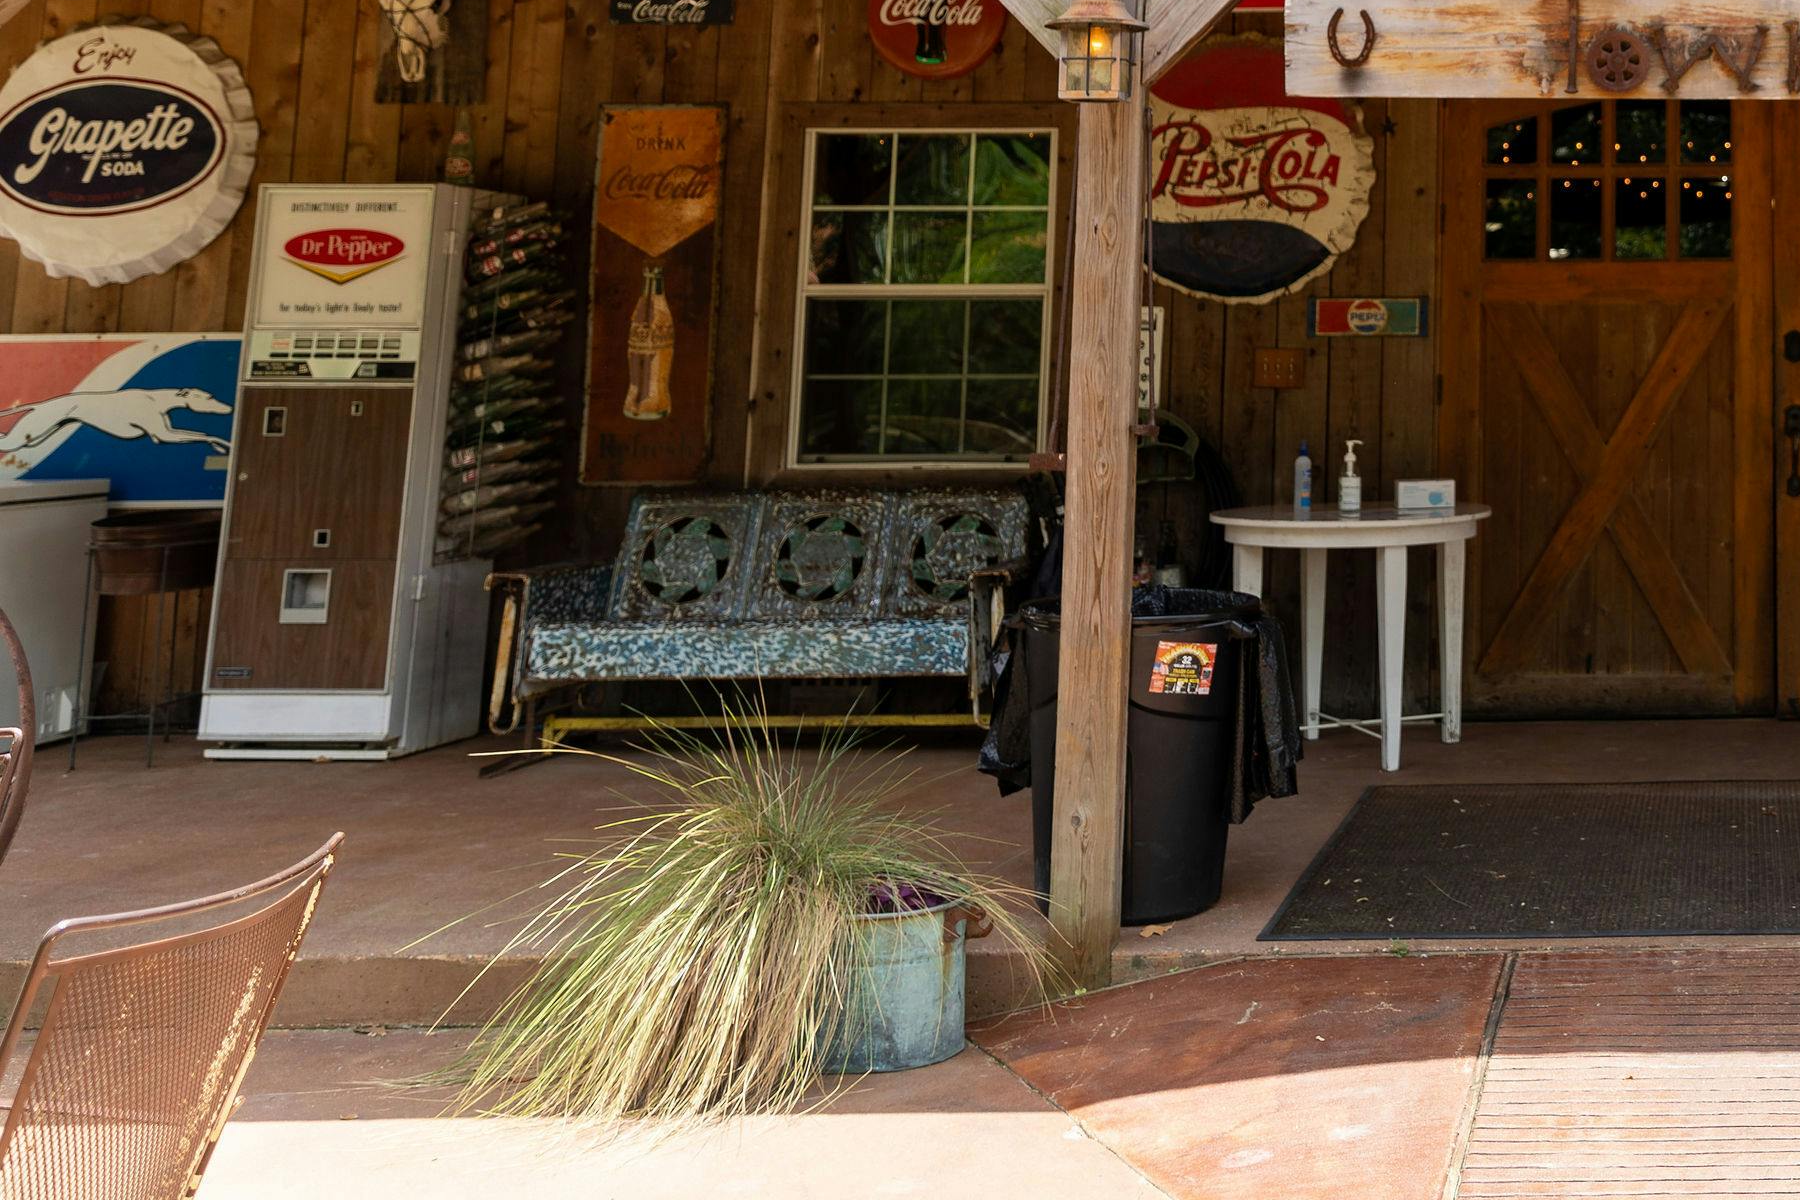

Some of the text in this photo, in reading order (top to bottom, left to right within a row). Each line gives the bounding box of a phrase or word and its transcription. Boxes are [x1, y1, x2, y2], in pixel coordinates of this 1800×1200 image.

[73, 36, 137, 74] Enjoy
[14, 103, 195, 185] Grapette
[636, 137, 687, 151] DRINK
[101, 161, 145, 177] SODA
[605, 163, 714, 201] Coca-Cola
[302, 234, 393, 263] Dr Pepper
[1181, 655, 1193, 665] 32
